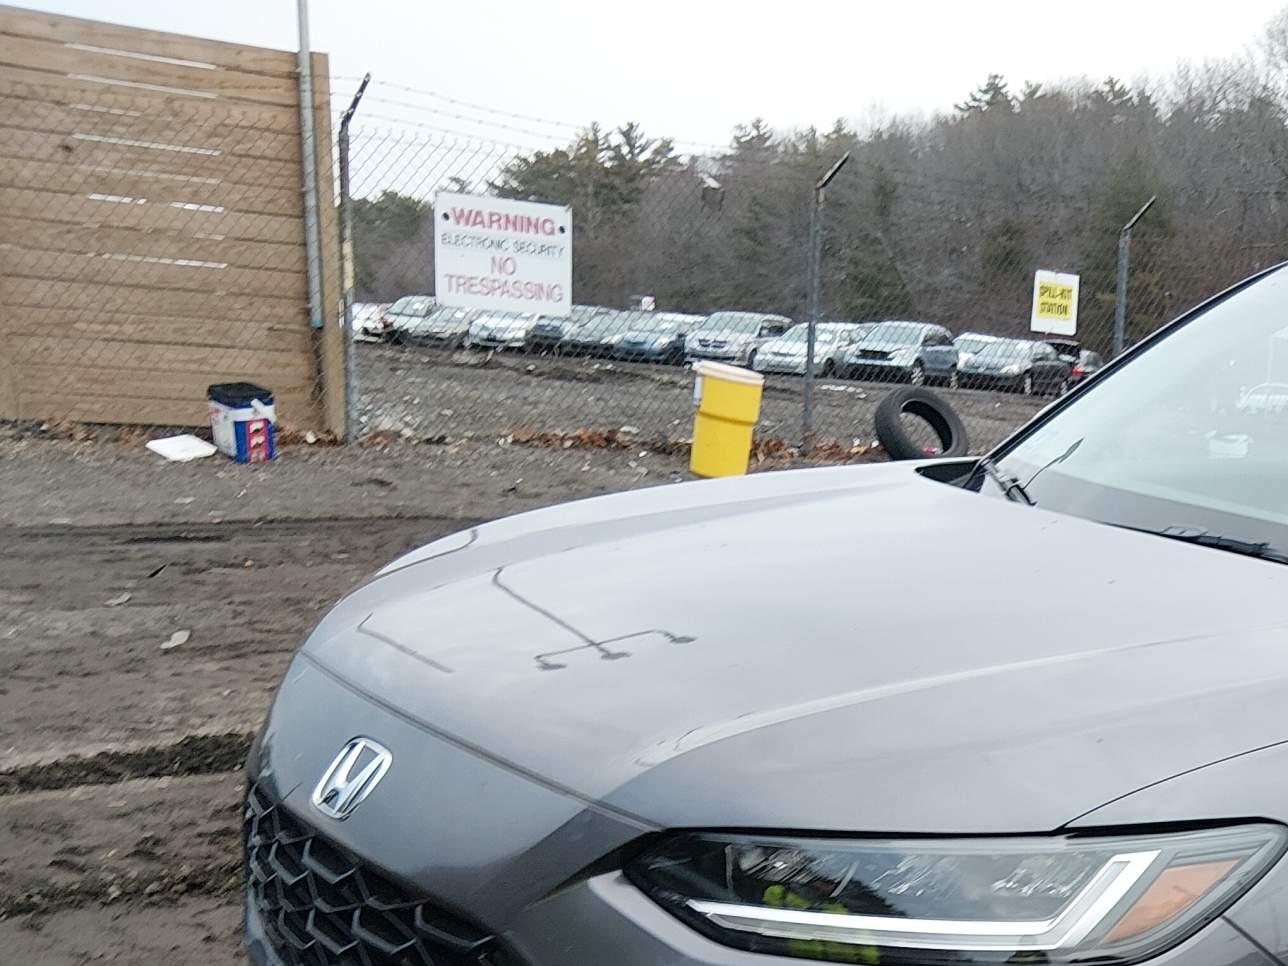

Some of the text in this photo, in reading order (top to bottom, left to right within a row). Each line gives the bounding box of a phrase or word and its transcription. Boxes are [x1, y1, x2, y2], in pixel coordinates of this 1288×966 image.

[452, 207, 556, 236] WARNING
[441, 232, 565, 258] ELECTRONIC SECURITY
[490, 256, 516, 276] NO
[444, 274, 563, 303] TRESPASSING
